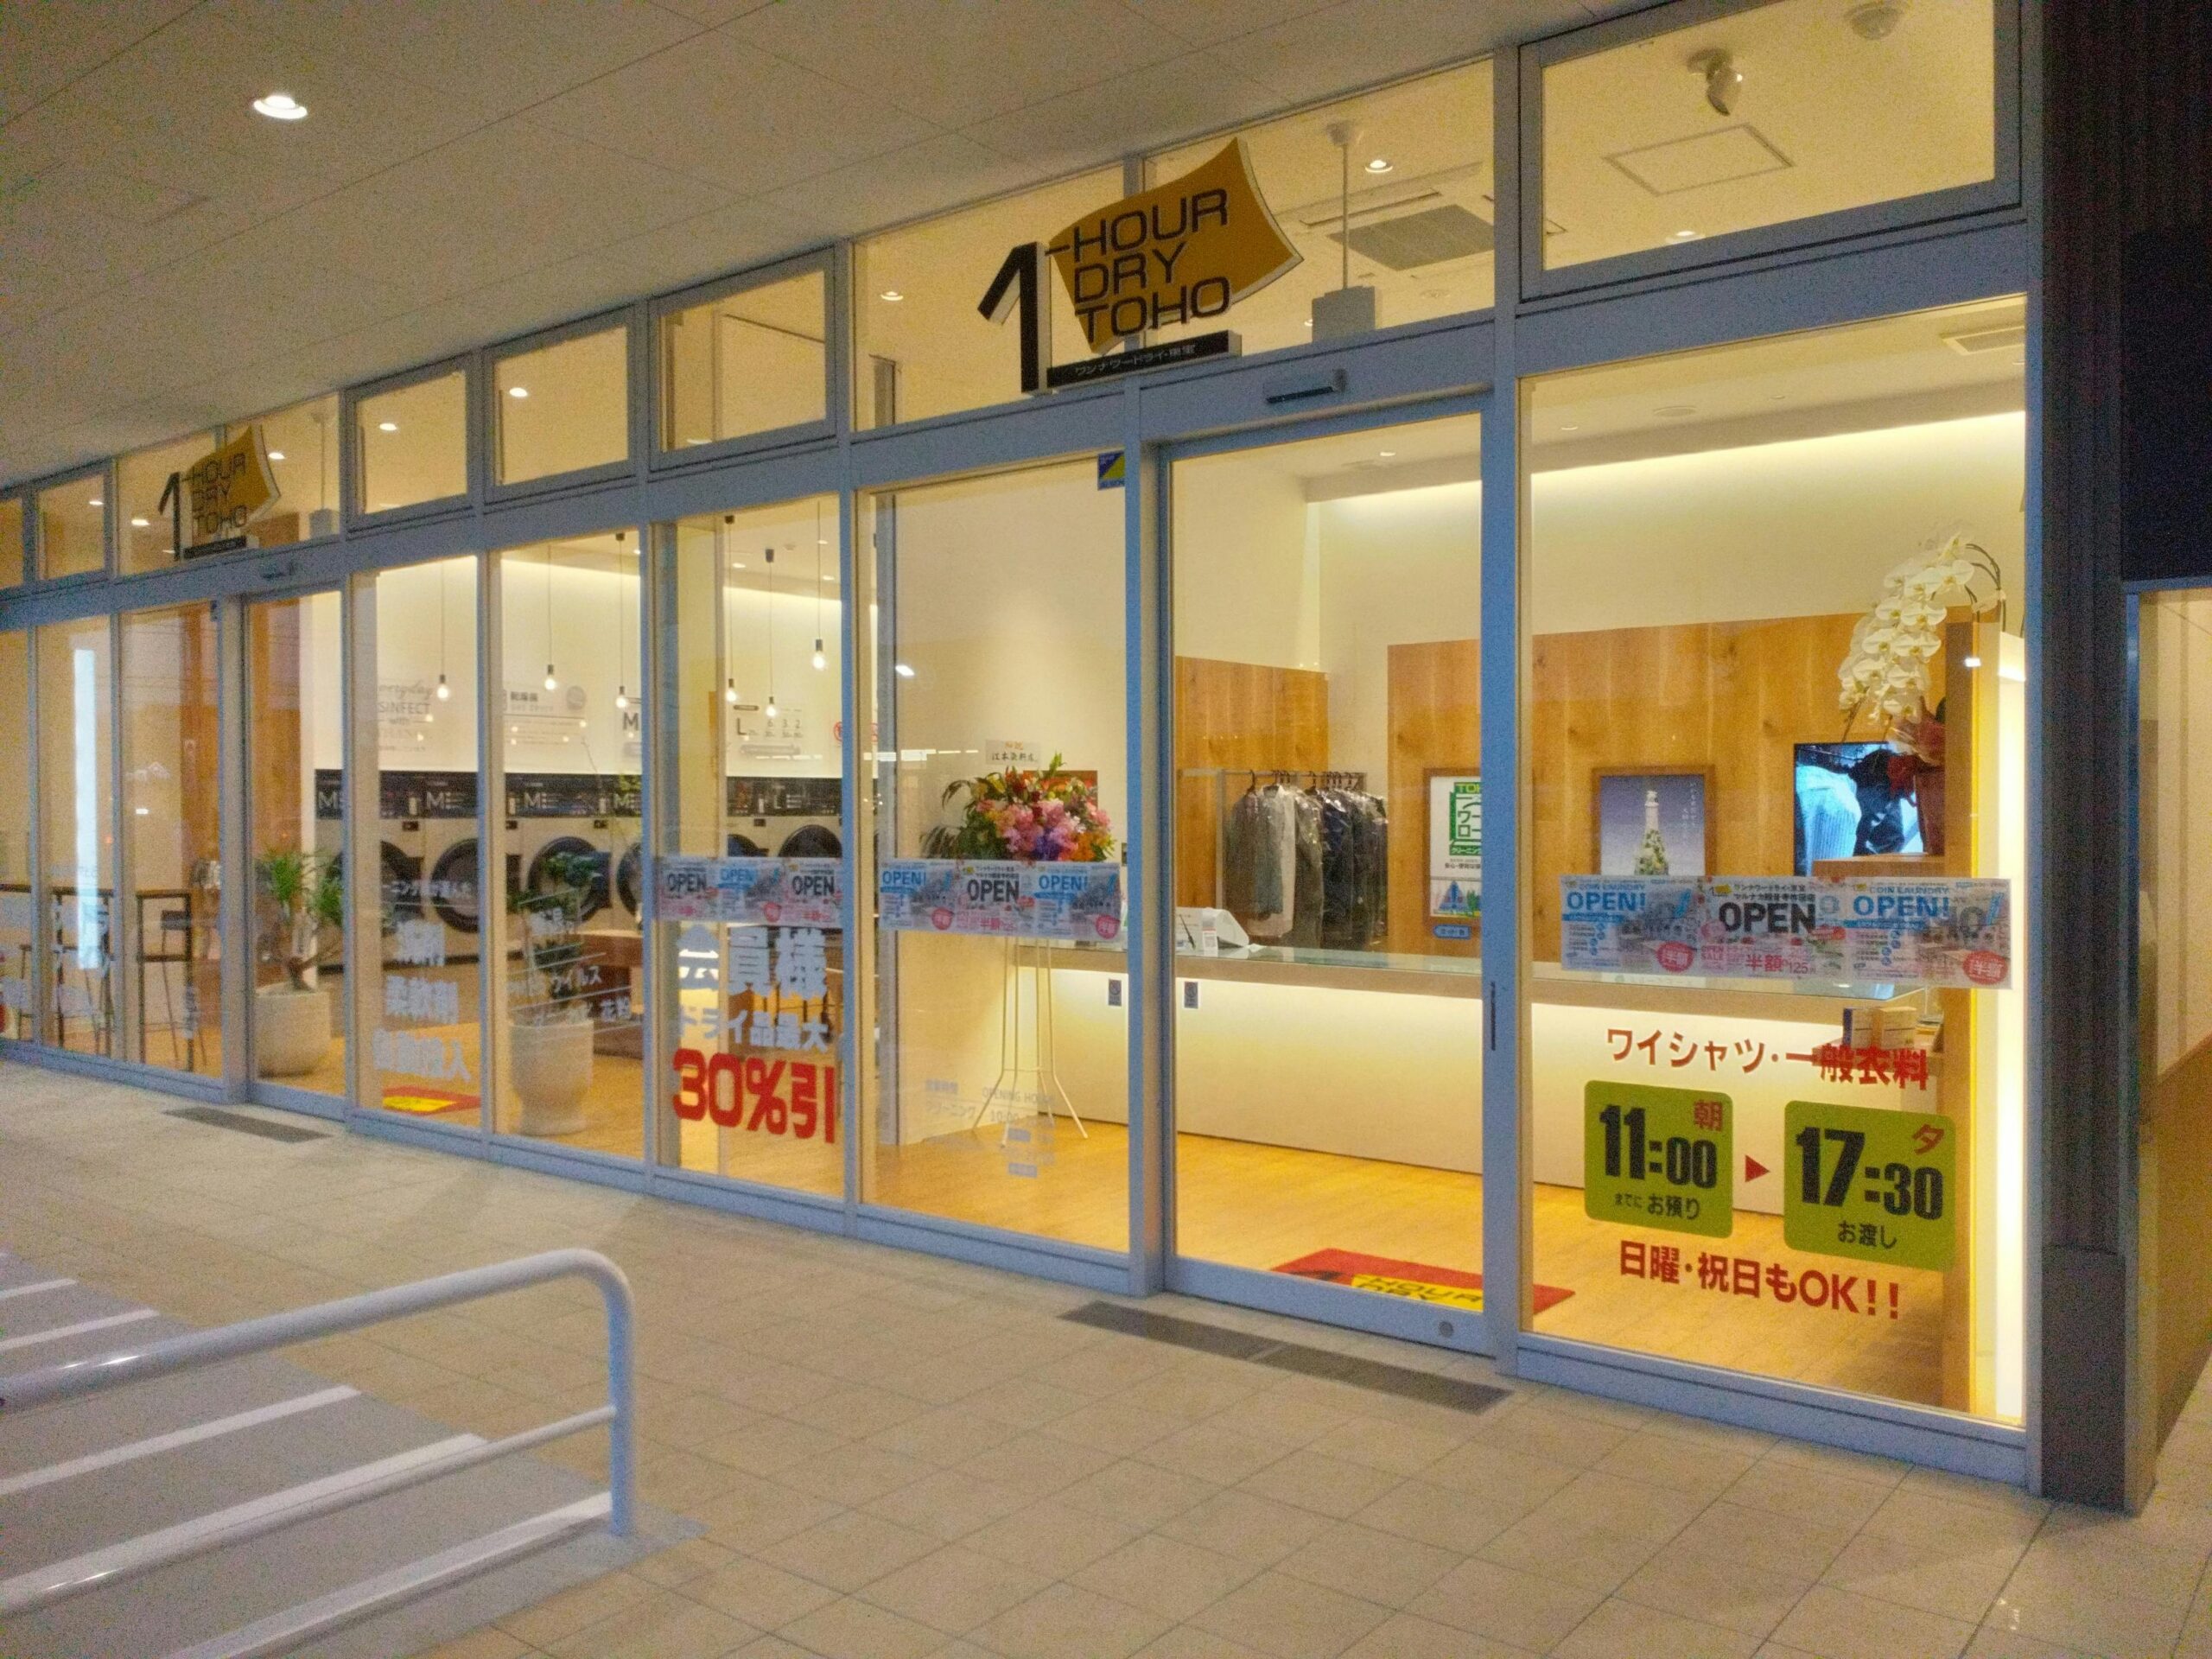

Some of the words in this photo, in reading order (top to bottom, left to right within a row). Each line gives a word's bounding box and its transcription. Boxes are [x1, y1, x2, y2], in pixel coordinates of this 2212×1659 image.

[1074, 240, 1189, 305] DRY
[1074, 275, 1232, 345] TOHO
[666, 873, 707, 893] OPEN
[791, 875, 835, 895] OPEN
[882, 870, 926, 886] OPEN!
[967, 879, 1020, 903] OPEN
[1039, 874, 1088, 891] OPEN!
[1567, 891, 1646, 912] OPEN!
[1719, 901, 1816, 934] OPEN
[1853, 894, 1950, 919] OPEN!
[676, 924, 828, 1000] 会員様
[677, 1004, 829, 1053] ドライ品最大
[1606, 1027, 1929, 1090] ワイシャツ・一般衣料
[672, 1047, 836, 1145] 30%引
[1693, 1100, 1723, 1132] 朝
[1599, 1104, 1718, 1190] 11:00
[1795, 1126, 1944, 1222] 17:30
[1837, 1220, 1897, 1250] お渡し
